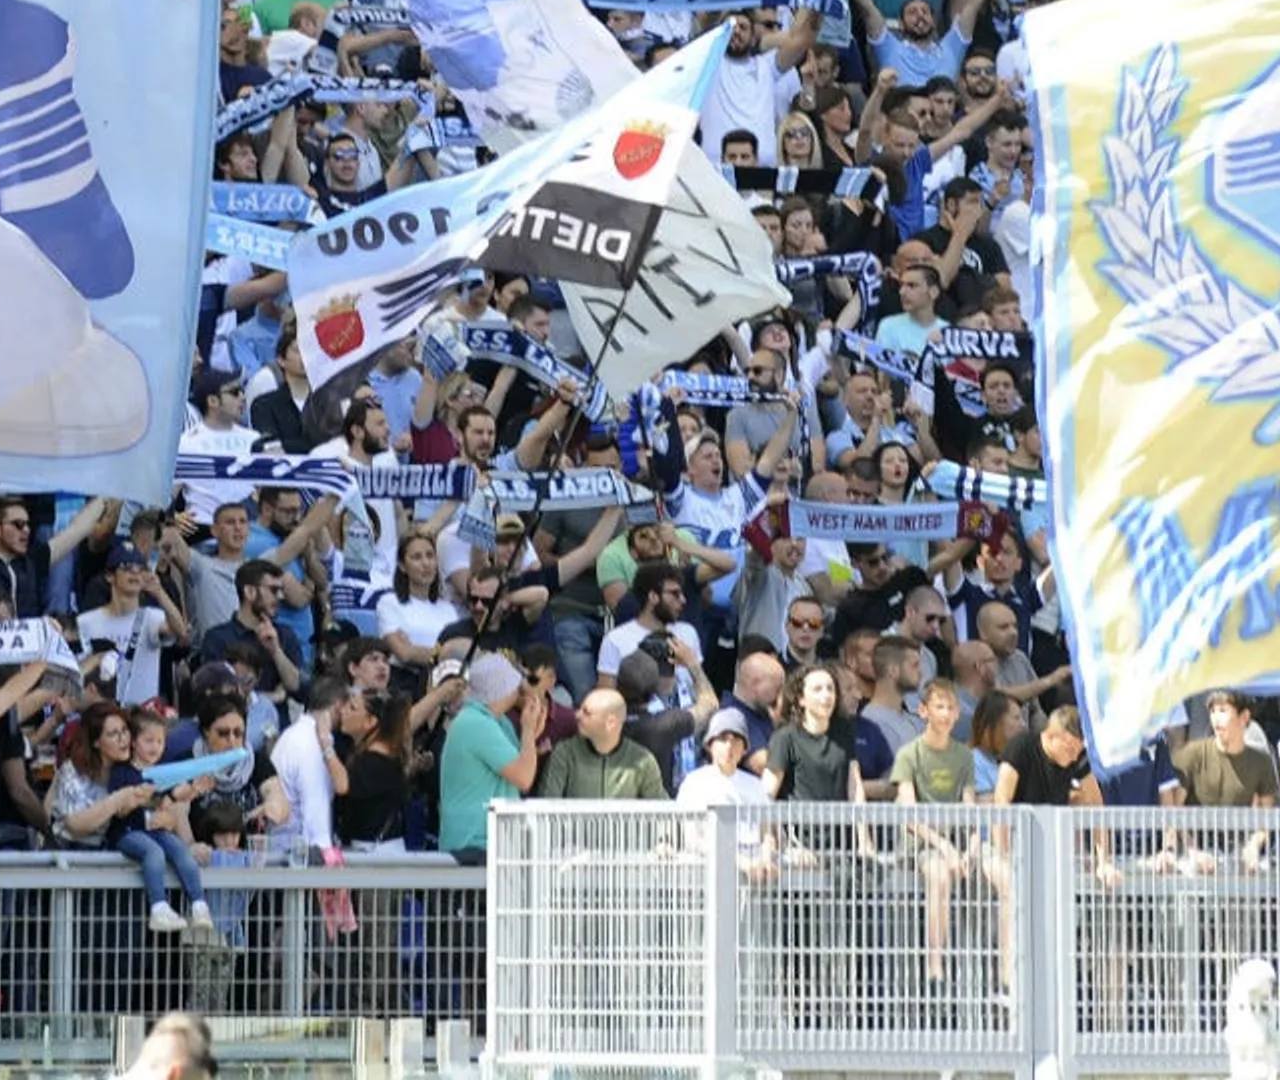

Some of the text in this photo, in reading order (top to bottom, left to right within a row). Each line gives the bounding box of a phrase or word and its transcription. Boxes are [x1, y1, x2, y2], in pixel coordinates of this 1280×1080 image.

[227, 186, 304, 212] LAZIO
[216, 225, 290, 257] LAZI
[357, 463, 456, 500] DUCIBILI
[548, 474, 616, 500] LAZIO
[807, 512, 943, 532] WEST HAM UNITED
